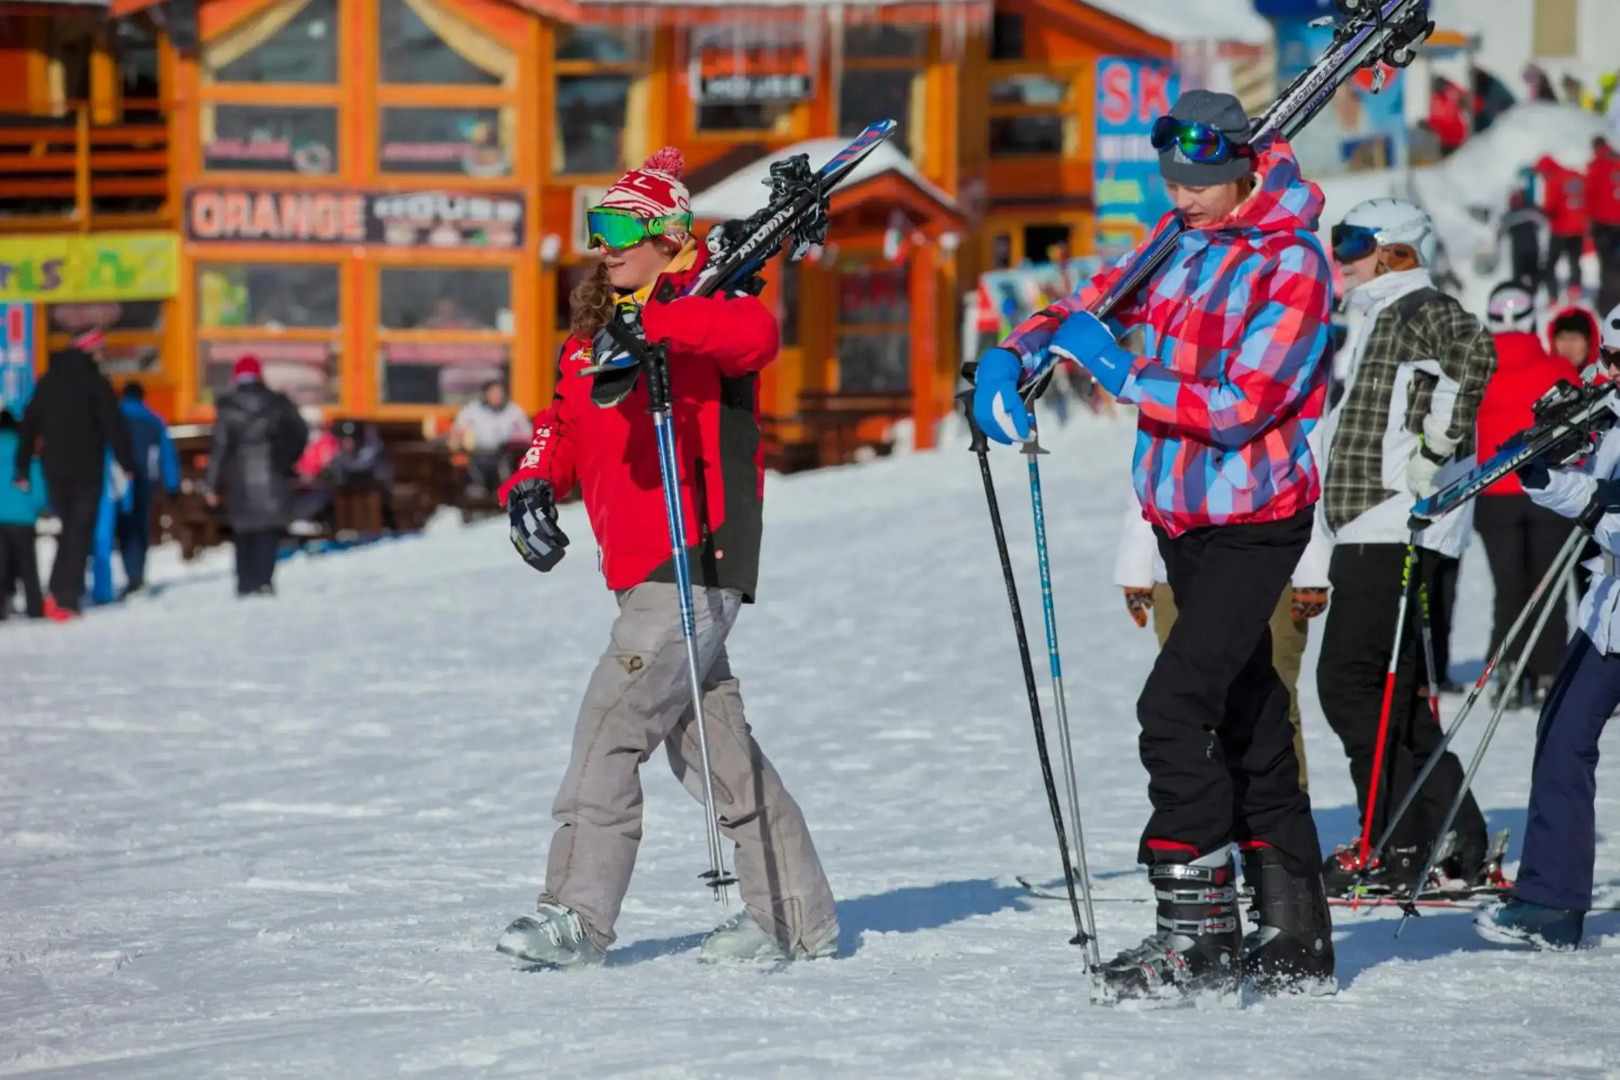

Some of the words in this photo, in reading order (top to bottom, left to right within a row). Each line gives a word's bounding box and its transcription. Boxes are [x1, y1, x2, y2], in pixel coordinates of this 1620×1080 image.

[192, 192, 366, 240] ORANGE
[738, 204, 796, 260] ATOMIC
[1459, 447, 1534, 502] ATOMIC
